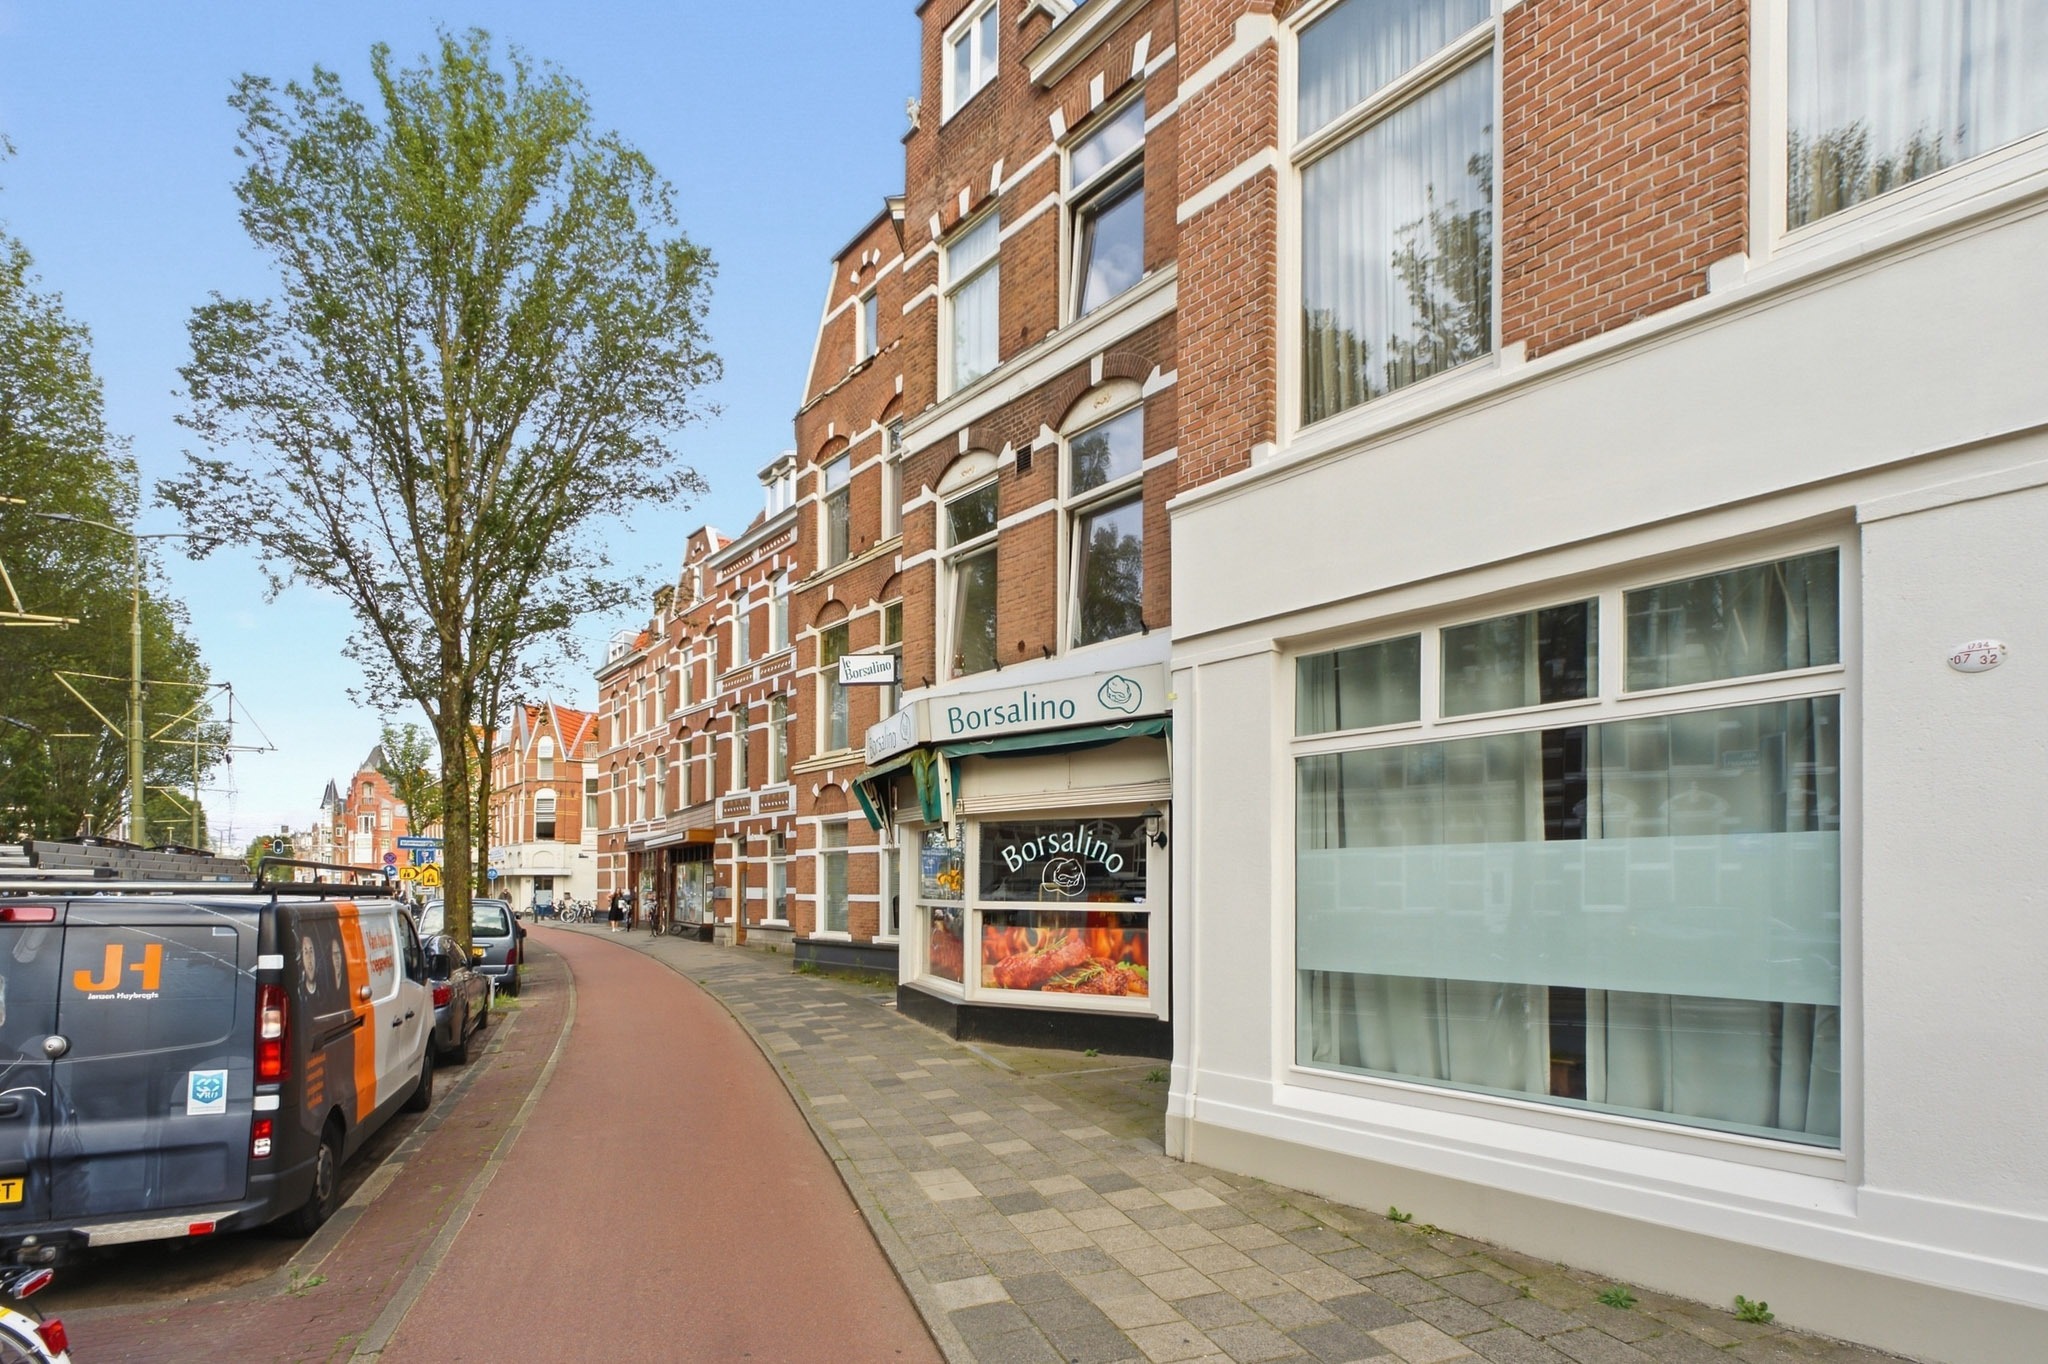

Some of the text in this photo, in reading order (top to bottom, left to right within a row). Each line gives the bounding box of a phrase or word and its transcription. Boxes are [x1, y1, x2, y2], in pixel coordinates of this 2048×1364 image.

[841, 657, 851, 669] le
[844, 661, 892, 680] Borsalino
[947, 690, 1076, 734] Borsalino
[1001, 824, 1124, 873] Borsalino
